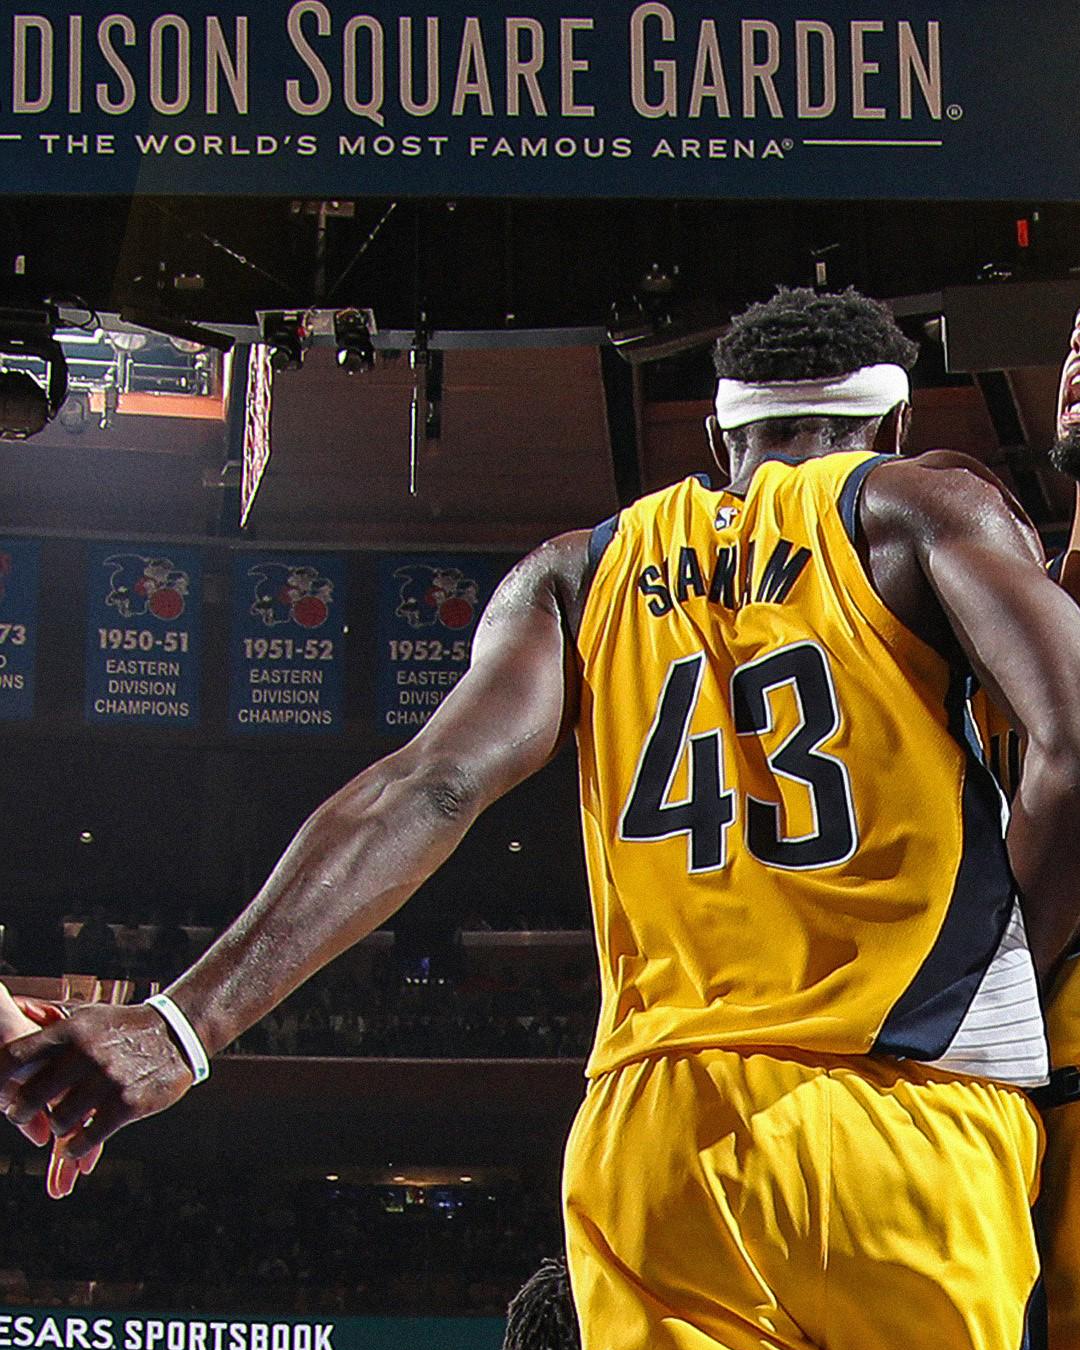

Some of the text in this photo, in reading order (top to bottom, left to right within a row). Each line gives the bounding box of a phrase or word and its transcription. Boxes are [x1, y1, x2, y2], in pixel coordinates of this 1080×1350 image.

[13, 13, 249, 115] DISON
[286, 0, 595, 127] SQUARE
[39, 134, 116, 155] THE
[136, 134, 318, 156] WORLD'S
[338, 135, 449, 157] MOST
[469, 136, 633, 159] FAMOUS
[98, 627, 189, 653] 1950-51
[243, 638, 334, 661] 1951-52
[388, 639, 471, 661] 1952-5
[106, 659, 180, 677] EASTERN
[249, 669, 323, 685] EASTERN
[108, 679, 177, 697] DIVISION
[252, 688, 320, 705] DIVISION
[94, 699, 190, 717] CHAMPIONS
[238, 709, 333, 725] CHAMPIONS
[619, 639, 859, 875] 43
